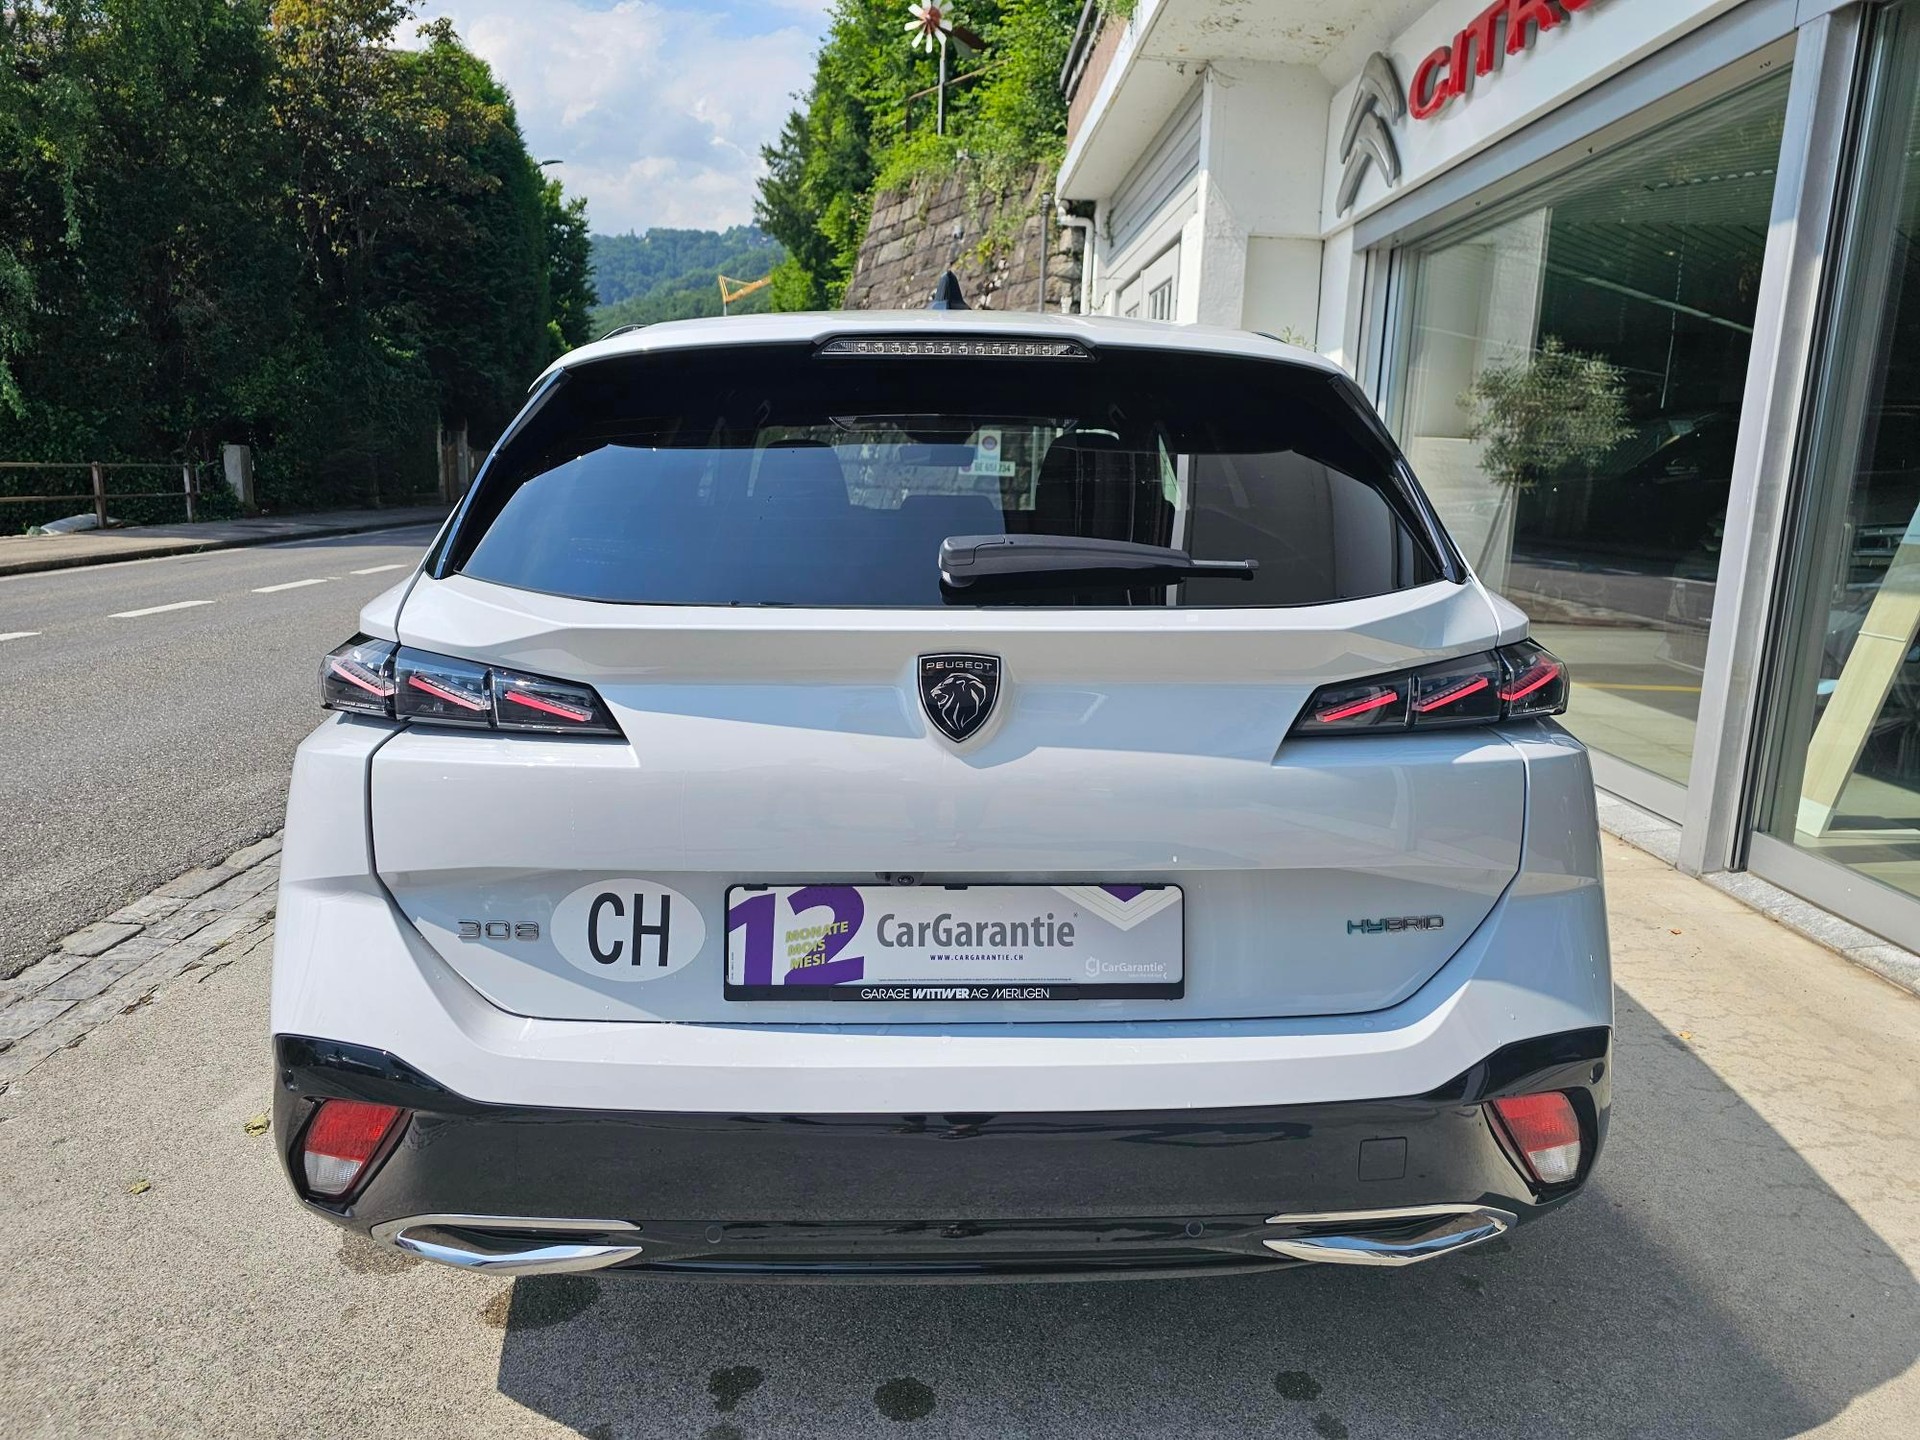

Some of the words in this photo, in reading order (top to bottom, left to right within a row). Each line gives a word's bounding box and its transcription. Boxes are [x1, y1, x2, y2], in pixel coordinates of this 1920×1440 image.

[1409, 0, 1592, 120] CITR
[926, 661, 992, 670] PEUGEOT
[457, 919, 540, 941] 308
[588, 892, 671, 967] CH
[785, 921, 849, 942] MONATE
[877, 912, 1075, 947] CarGarantie
[1347, 915, 1444, 935] HYBRID
[729, 886, 864, 985] 12
[787, 939, 826, 957] MOIS
[790, 953, 827, 970] MESI
[1101, 961, 1164, 972] CarGarantie
[861, 988, 910, 999] GARAGE
[912, 988, 970, 999] WITTWER
[970, 988, 988, 999] AG
[991, 988, 1050, 999] MERLIGEN
